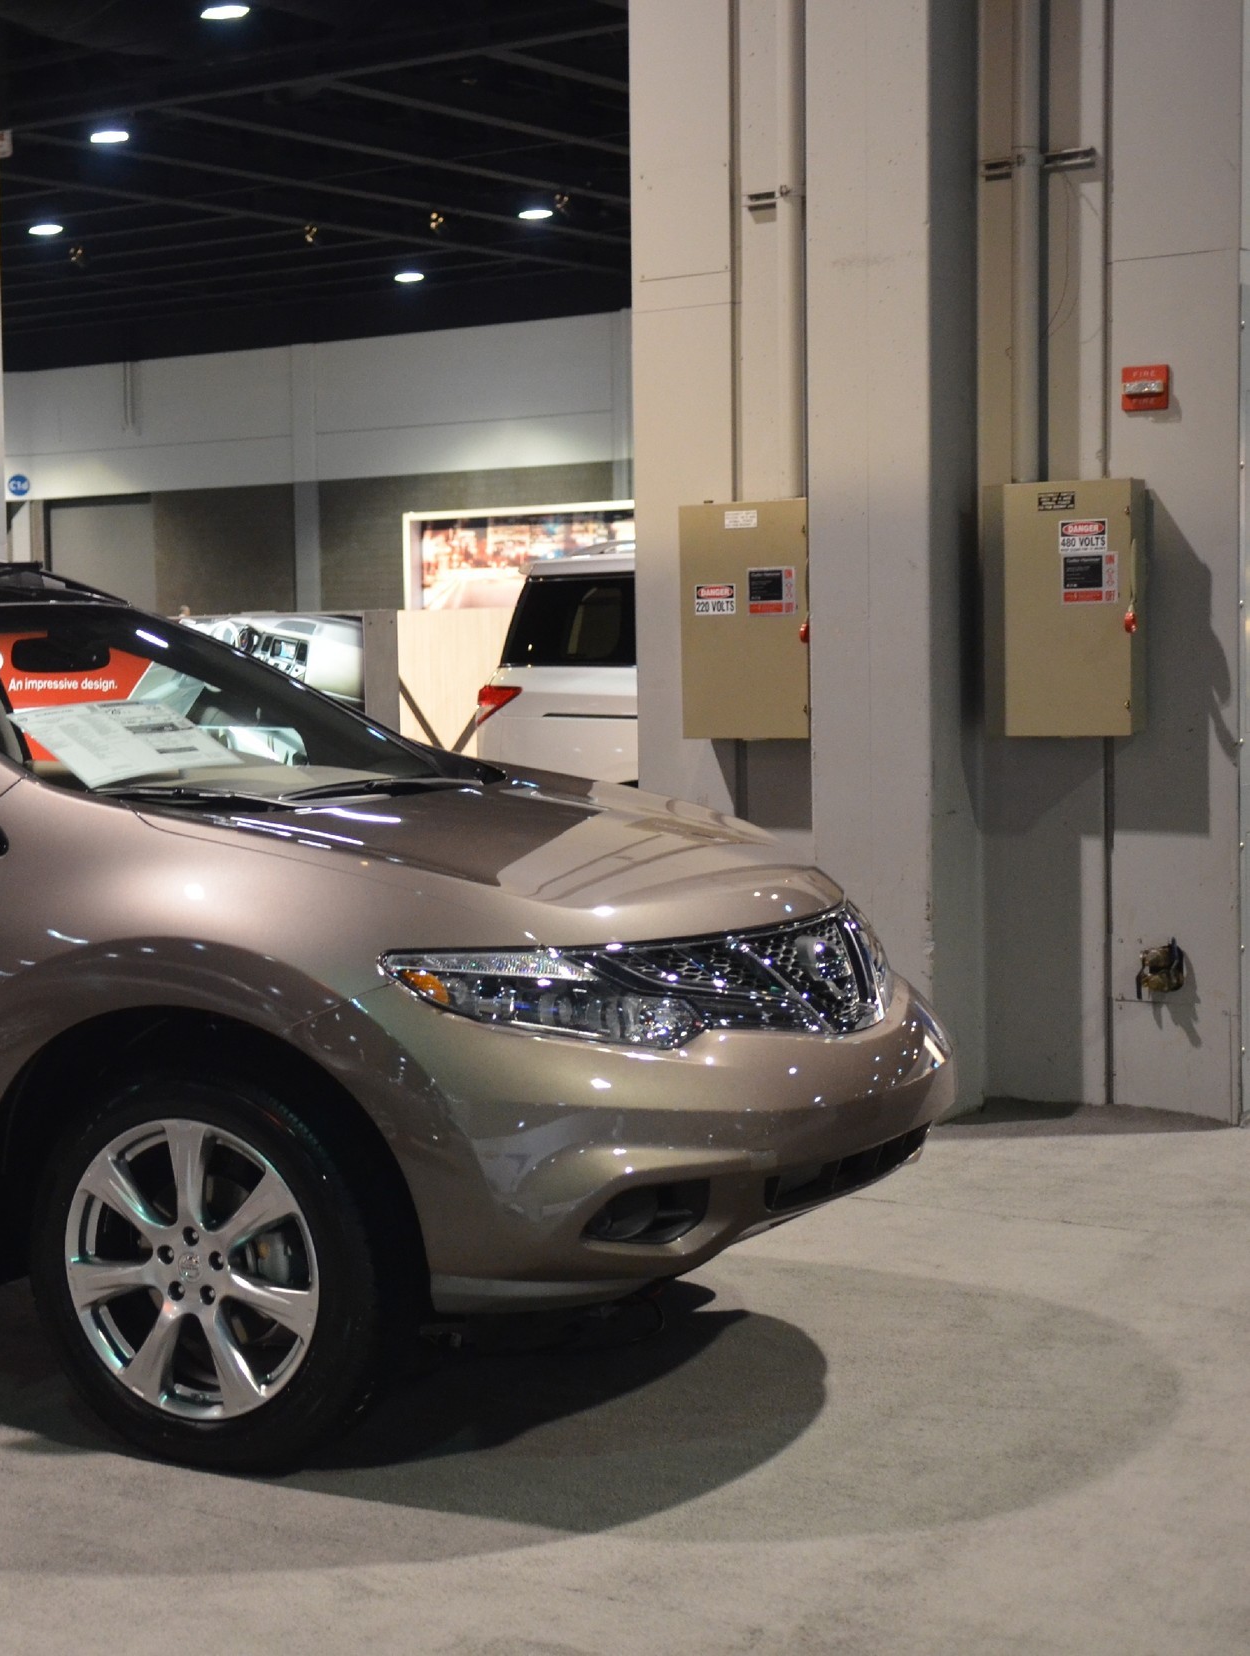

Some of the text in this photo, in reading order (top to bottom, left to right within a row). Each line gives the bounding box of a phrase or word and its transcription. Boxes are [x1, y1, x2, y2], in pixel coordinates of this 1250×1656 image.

[1068, 524, 1099, 533] DANGER
[1061, 536, 1106, 547] 480 VOLTS
[700, 588, 730, 598] DANGER
[696, 600, 735, 613] 220 VOLTS
[8, 677, 118, 692] An impressive design.
